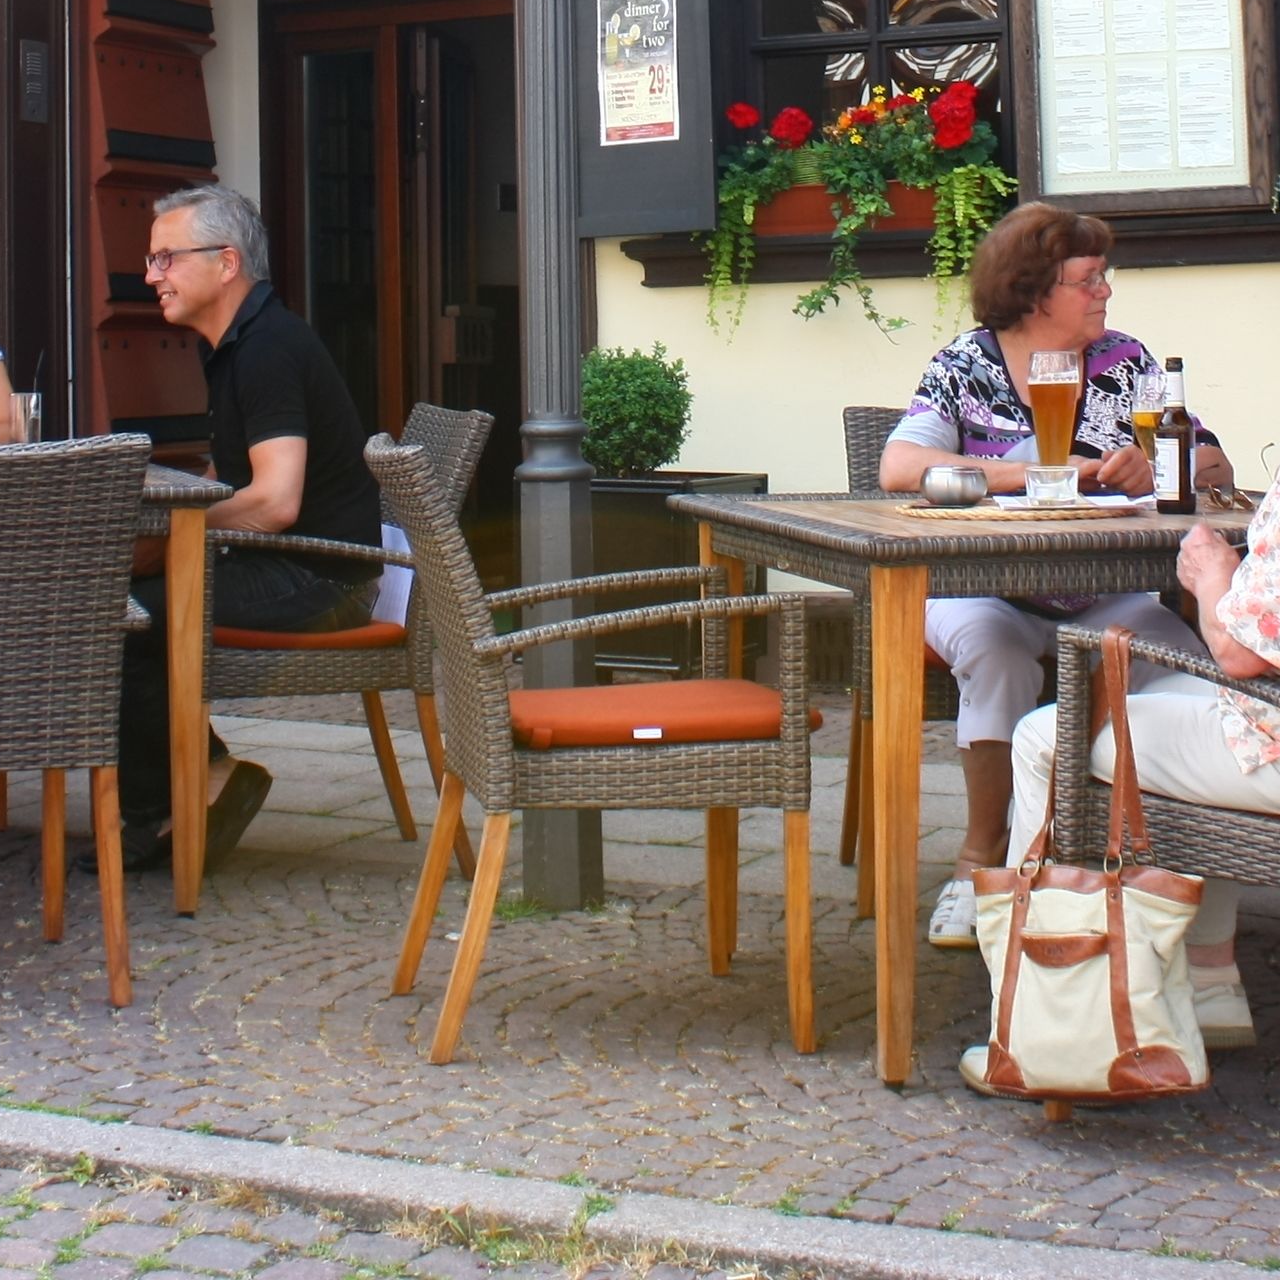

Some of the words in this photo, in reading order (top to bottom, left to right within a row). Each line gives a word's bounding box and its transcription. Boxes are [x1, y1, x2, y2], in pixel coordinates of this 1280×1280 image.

[624, 1, 661, 18] dinner
[652, 15, 670, 32] for
[642, 34, 665, 49] two
